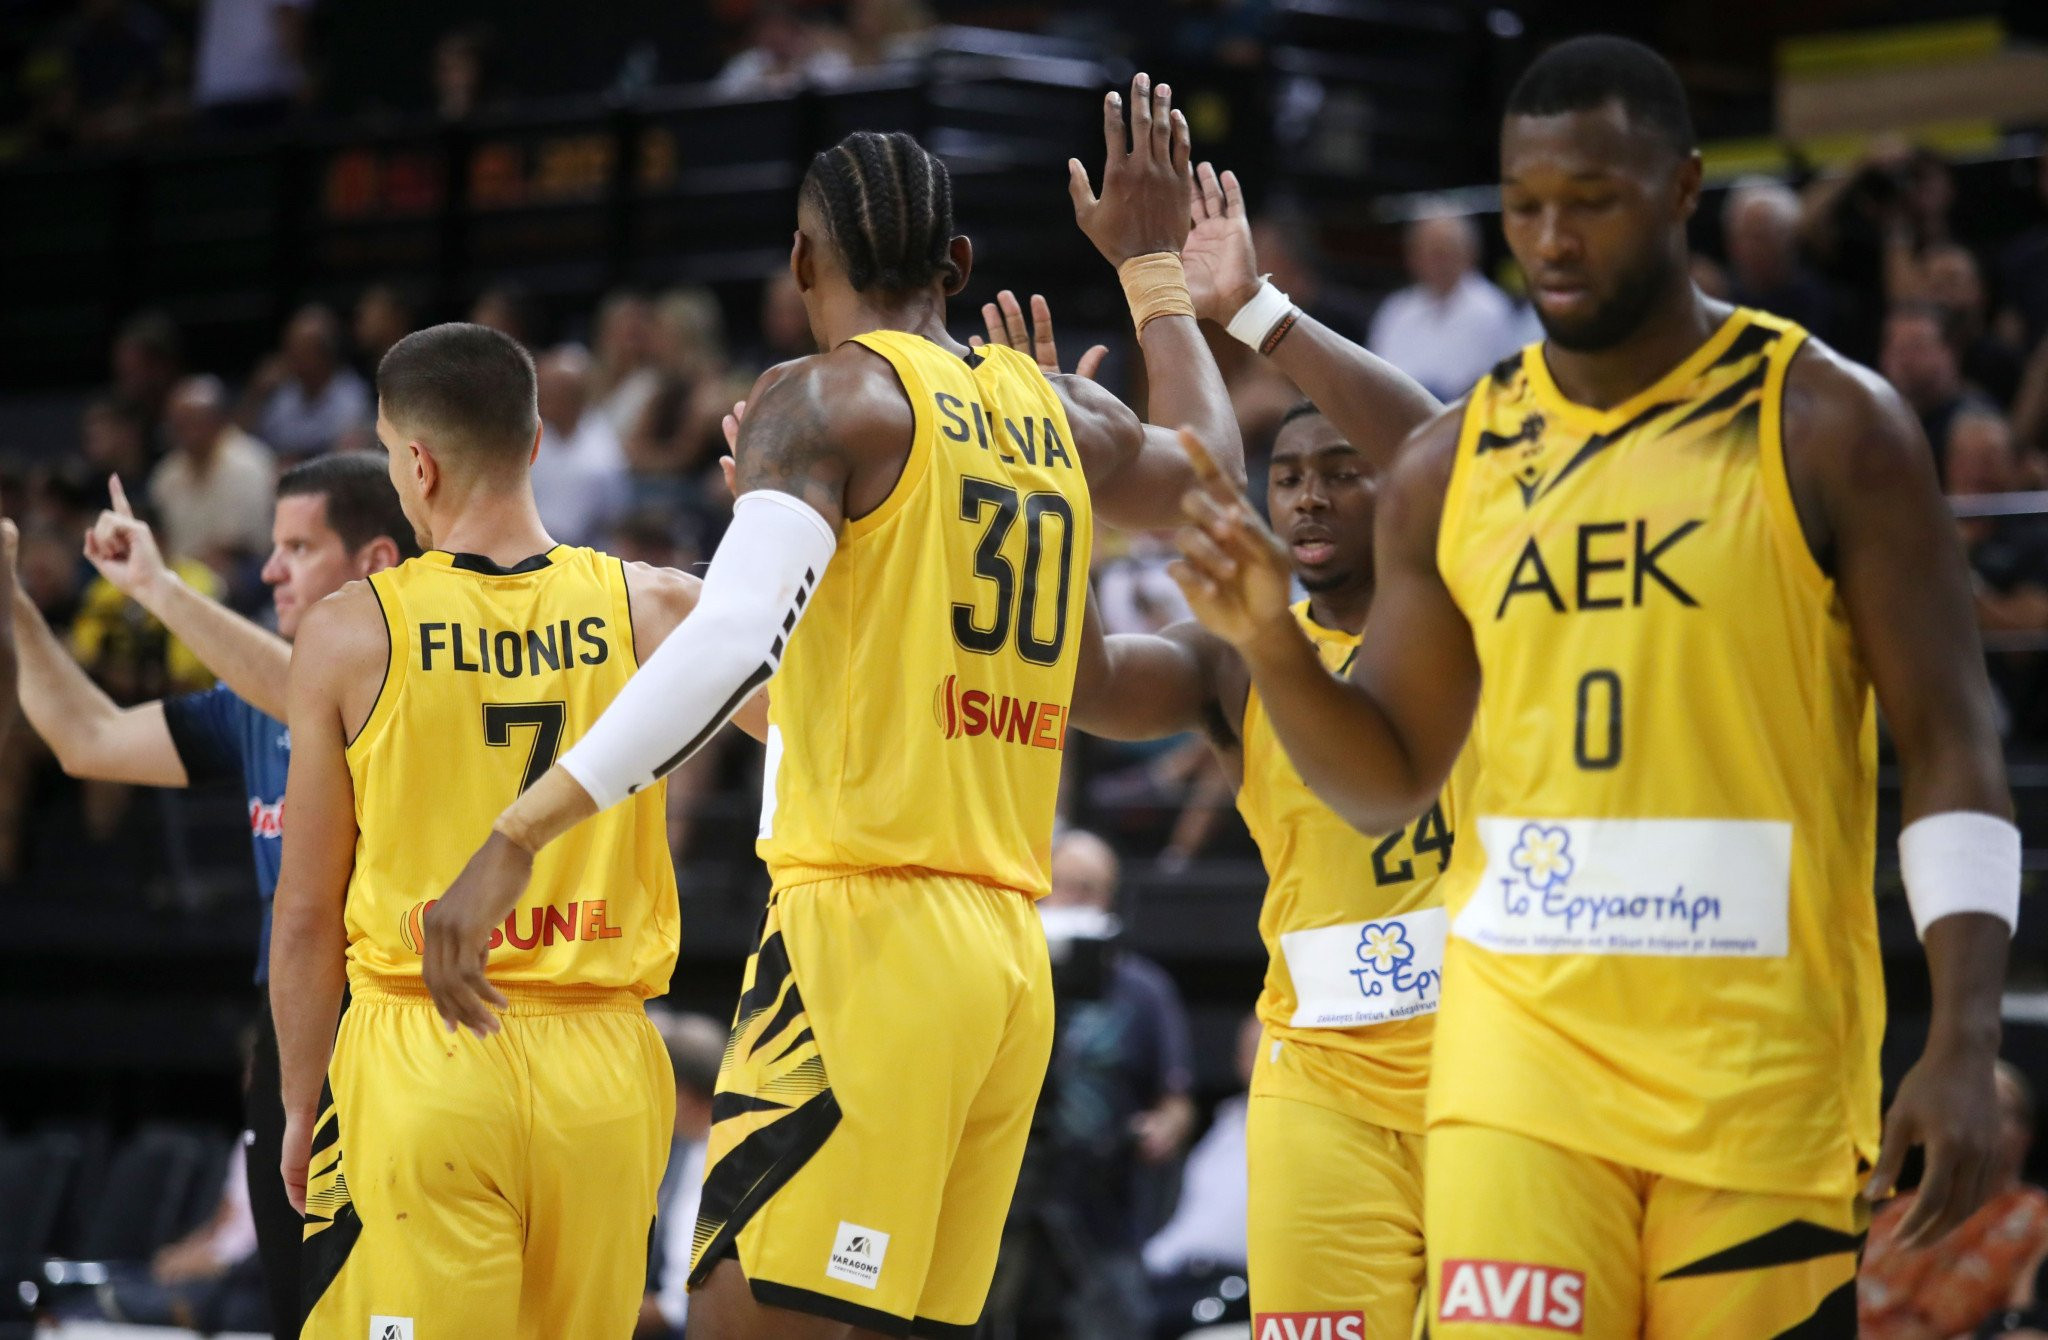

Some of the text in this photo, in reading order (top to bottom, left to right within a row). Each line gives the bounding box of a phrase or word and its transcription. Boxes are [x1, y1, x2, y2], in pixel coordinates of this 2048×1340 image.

[934, 391, 1073, 470] SILVA
[951, 474, 1074, 667] 30
[1494, 518, 1707, 621] AEK
[419, 616, 609, 678] FLIONIS
[482, 701, 566, 800] 7
[1574, 667, 1623, 772] 0
[1371, 798, 1455, 887] 24
[488, 899, 623, 951] UNEL
[832, 1254, 878, 1274] VARAGONS
[1441, 1263, 1583, 1328] AVIS
[1261, 1314, 1362, 1340] AVIS
